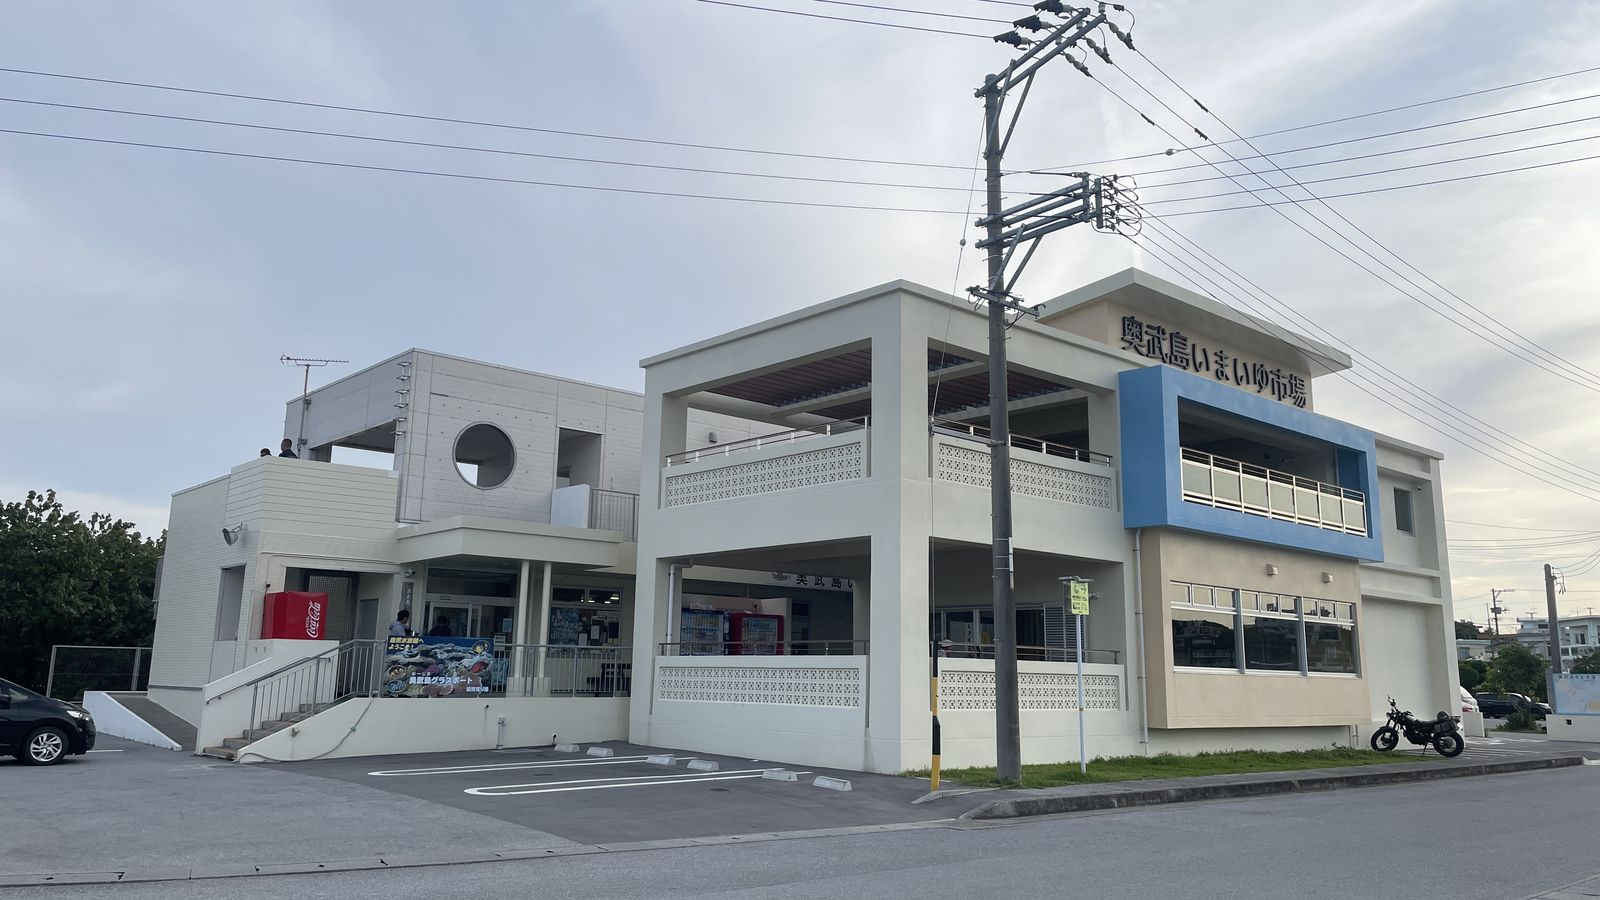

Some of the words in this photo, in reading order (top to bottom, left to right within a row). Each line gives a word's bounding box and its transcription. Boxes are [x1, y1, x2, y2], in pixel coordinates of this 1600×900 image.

[1121, 316, 1306, 408] 奥武島いまいゆ市場
[306, 600, 321, 638] Coca-Cola
